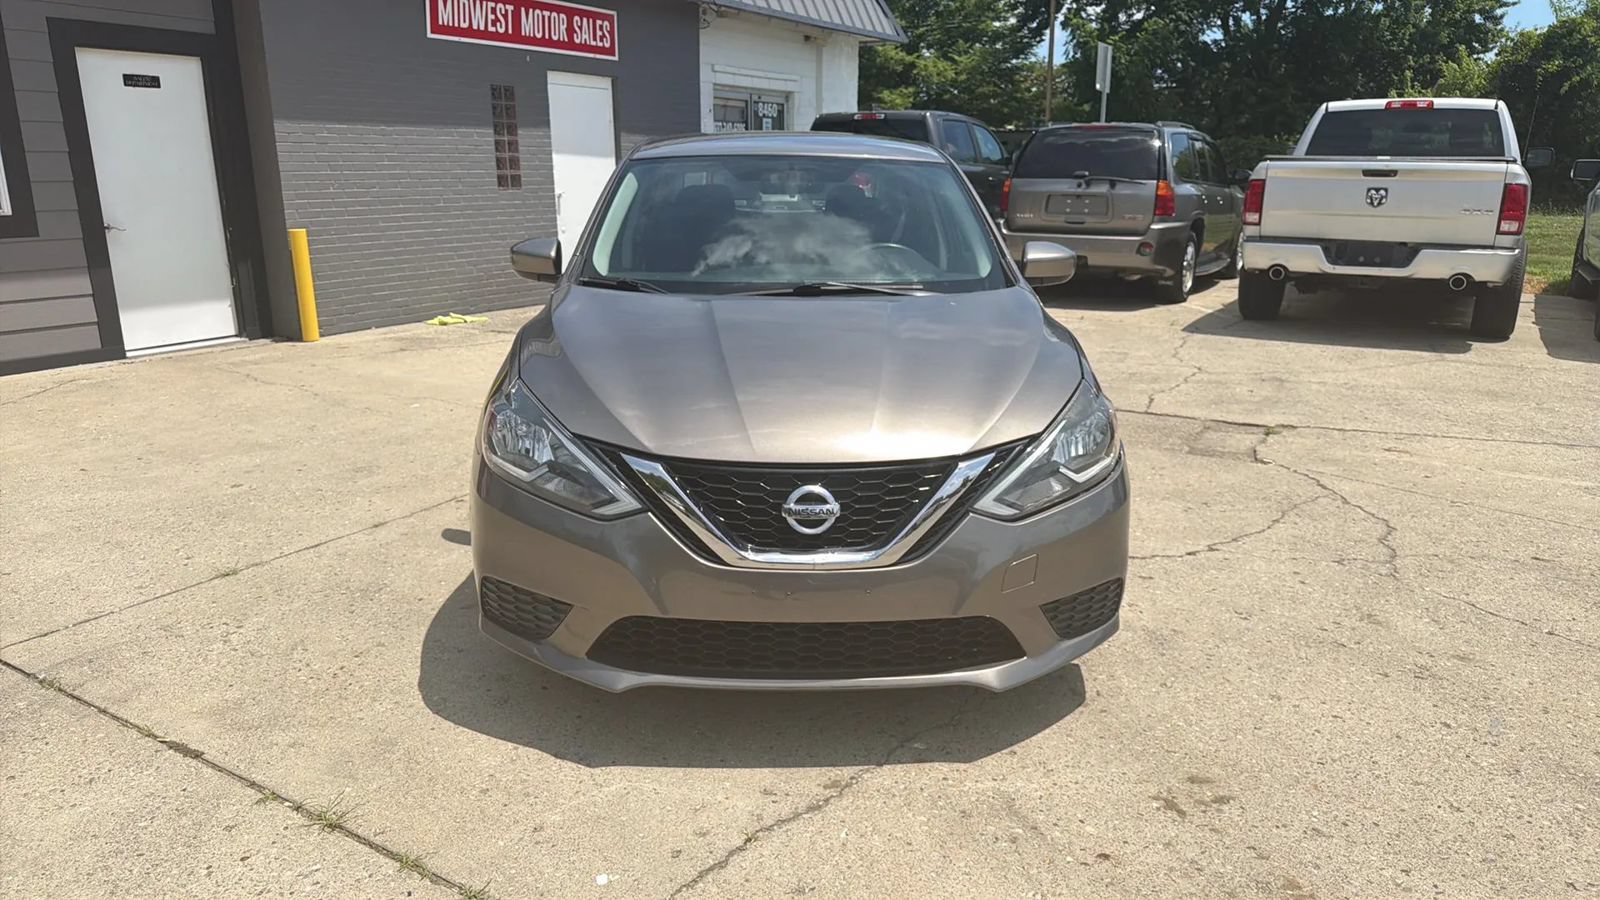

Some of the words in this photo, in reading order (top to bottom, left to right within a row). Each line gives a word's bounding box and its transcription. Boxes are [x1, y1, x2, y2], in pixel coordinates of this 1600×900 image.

[438, 0, 514, 34] MIDWEST
[520, 7, 568, 42] MOTOR
[573, 15, 611, 48] SALES
[758, 102, 778, 117] 8450
[787, 508, 835, 516] NISSAN
